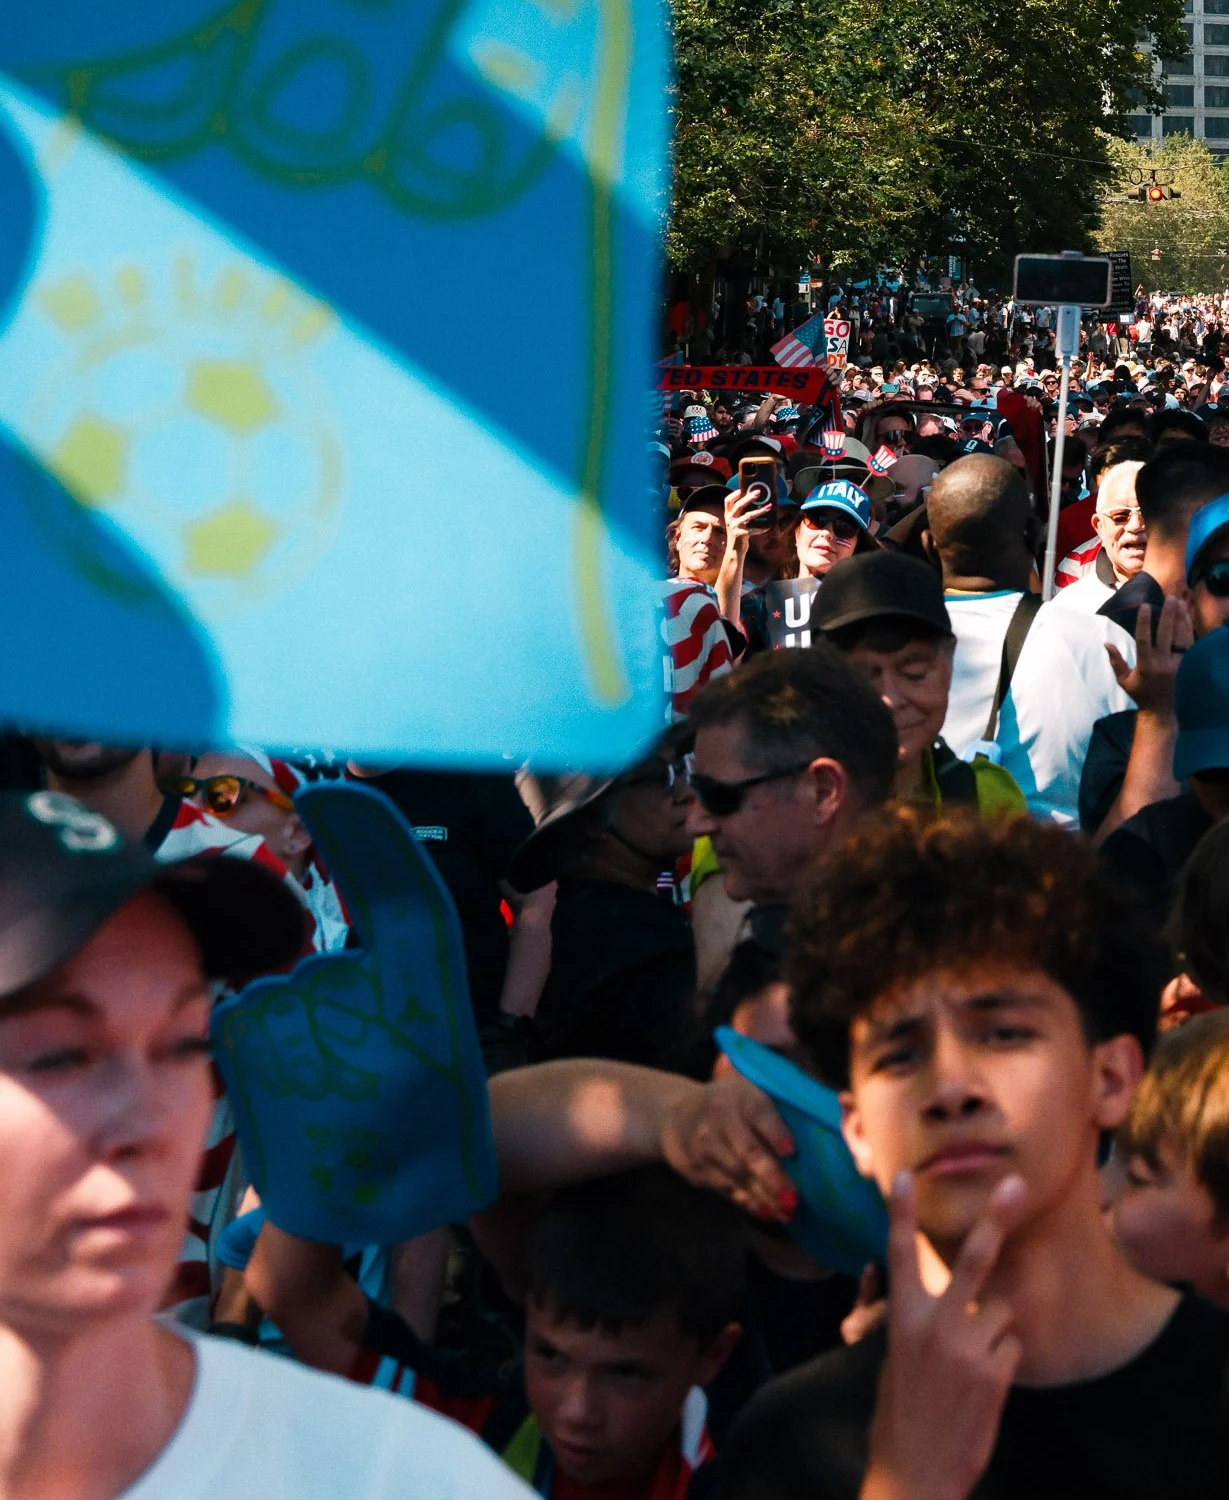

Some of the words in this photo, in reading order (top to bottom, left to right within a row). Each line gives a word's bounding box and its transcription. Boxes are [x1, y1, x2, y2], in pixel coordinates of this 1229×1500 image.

[824, 320, 850, 338] GO
[827, 337, 848, 354] SA
[711, 369, 809, 390] STATES
[818, 481, 865, 509] ITALY
[785, 591, 818, 628] U
